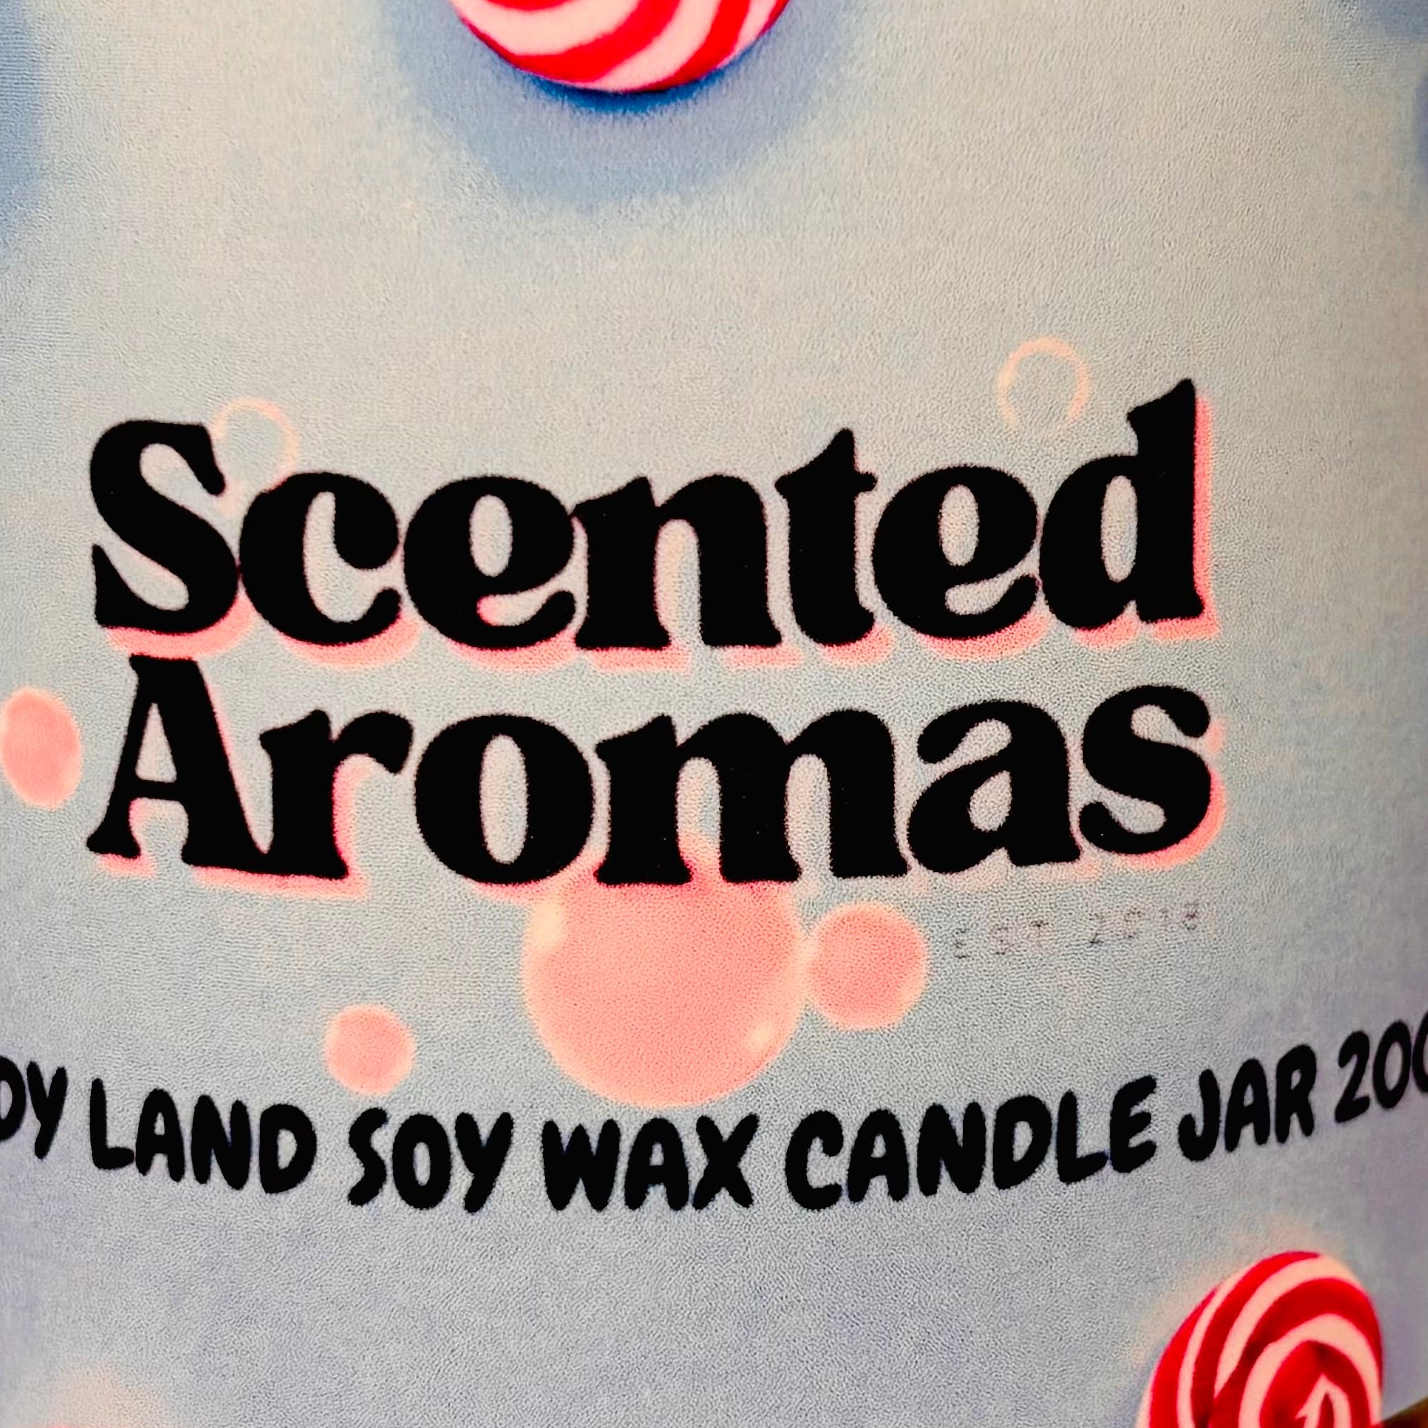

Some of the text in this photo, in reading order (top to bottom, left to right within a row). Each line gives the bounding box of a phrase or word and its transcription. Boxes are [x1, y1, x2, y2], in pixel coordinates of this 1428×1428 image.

[89, 378, 1206, 652] Scented
[85, 654, 1212, 886] Aromas
[951, 918, 1049, 958] EST
[88, 1077, 319, 1196] LAND
[346, 1107, 515, 1214] SOY
[539, 1112, 760, 1213] WAX
[783, 1074, 1159, 1213] CANDLE
[1177, 1043, 1319, 1164] JAR
